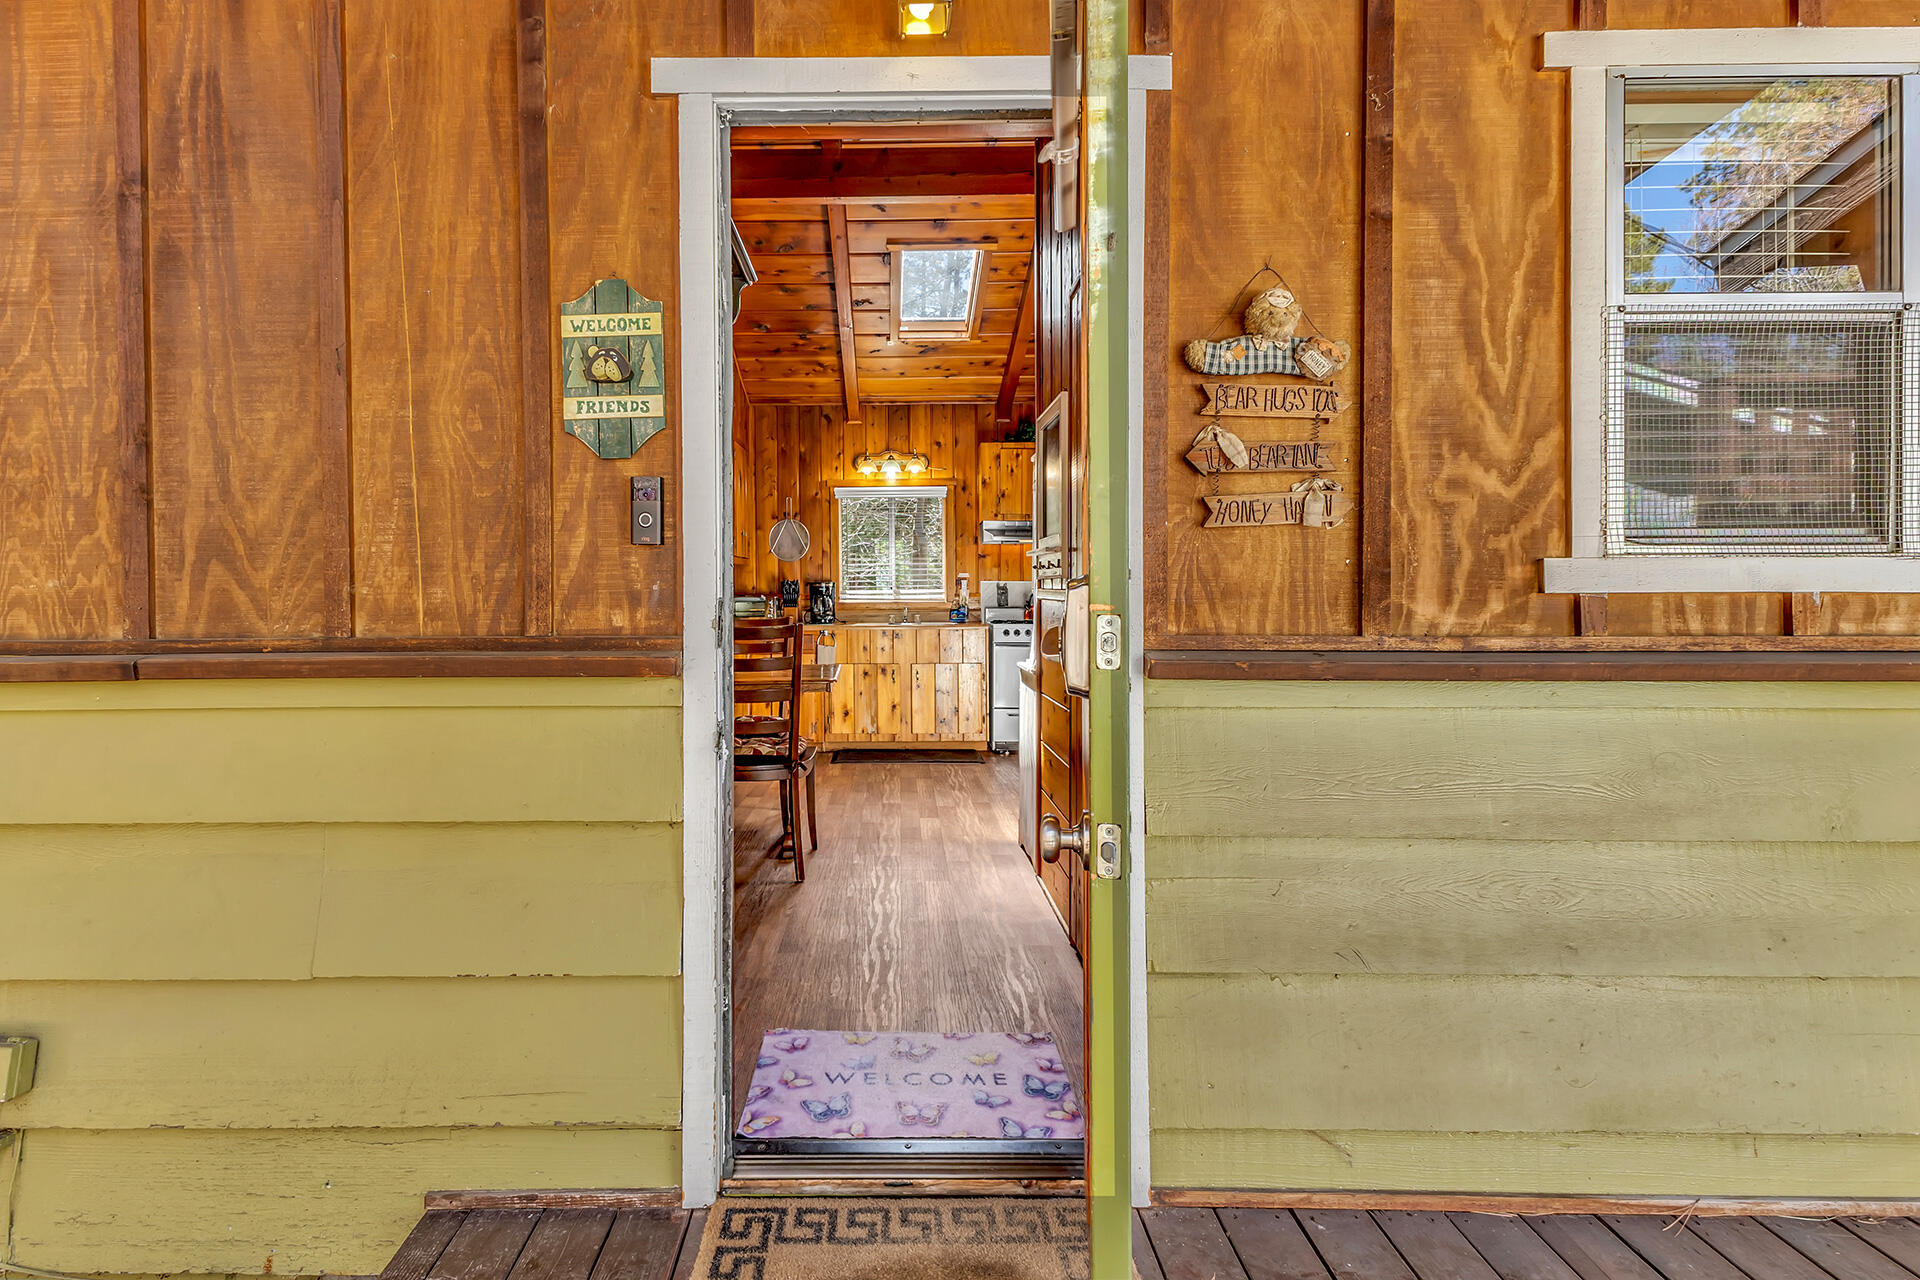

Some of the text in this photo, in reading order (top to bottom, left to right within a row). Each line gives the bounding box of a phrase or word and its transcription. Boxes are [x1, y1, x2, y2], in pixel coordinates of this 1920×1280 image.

[570, 318, 651, 333] WELCOME
[1309, 351, 1327, 369] HONEY
[576, 400, 650, 415] FRIENDS
[1215, 384, 1259, 410] BEAR
[1263, 386, 1308, 413] HUGS
[1249, 443, 1287, 470] BEAR
[1291, 443, 1329, 469] LANE
[1214, 494, 1333, 525] HONEY HAN
[825, 1071, 1008, 1087] WELCOME
